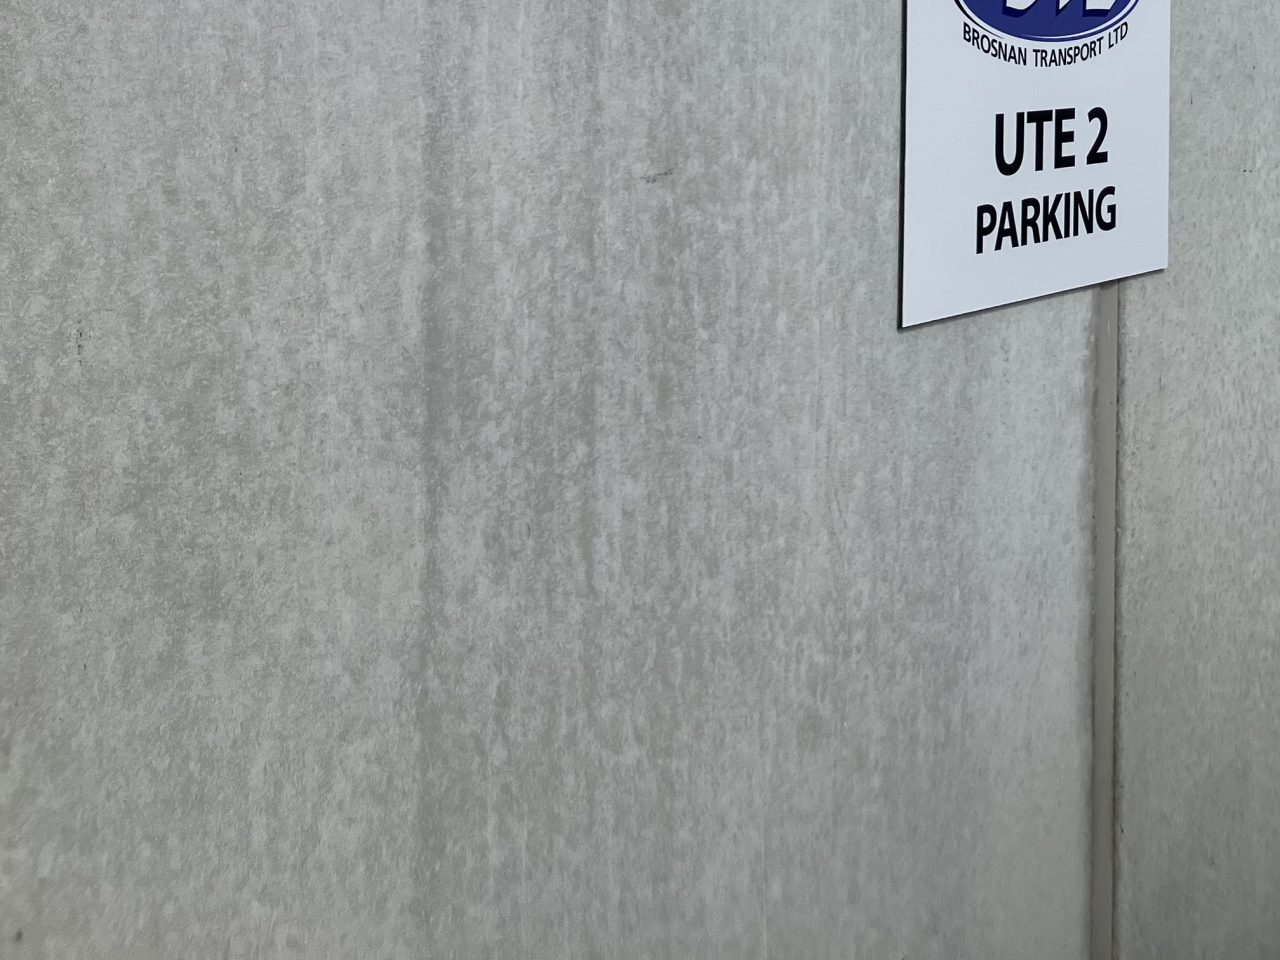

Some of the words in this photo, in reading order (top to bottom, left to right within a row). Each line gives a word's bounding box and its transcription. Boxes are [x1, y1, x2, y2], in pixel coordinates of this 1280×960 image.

[963, 21, 1028, 66] BROSNAN
[1033, 36, 1104, 67] TRANSPORT
[1107, 21, 1129, 50] LTD
[994, 107, 1076, 177] UTE
[1086, 106, 1109, 165] 2
[975, 185, 1117, 255] PARKING
